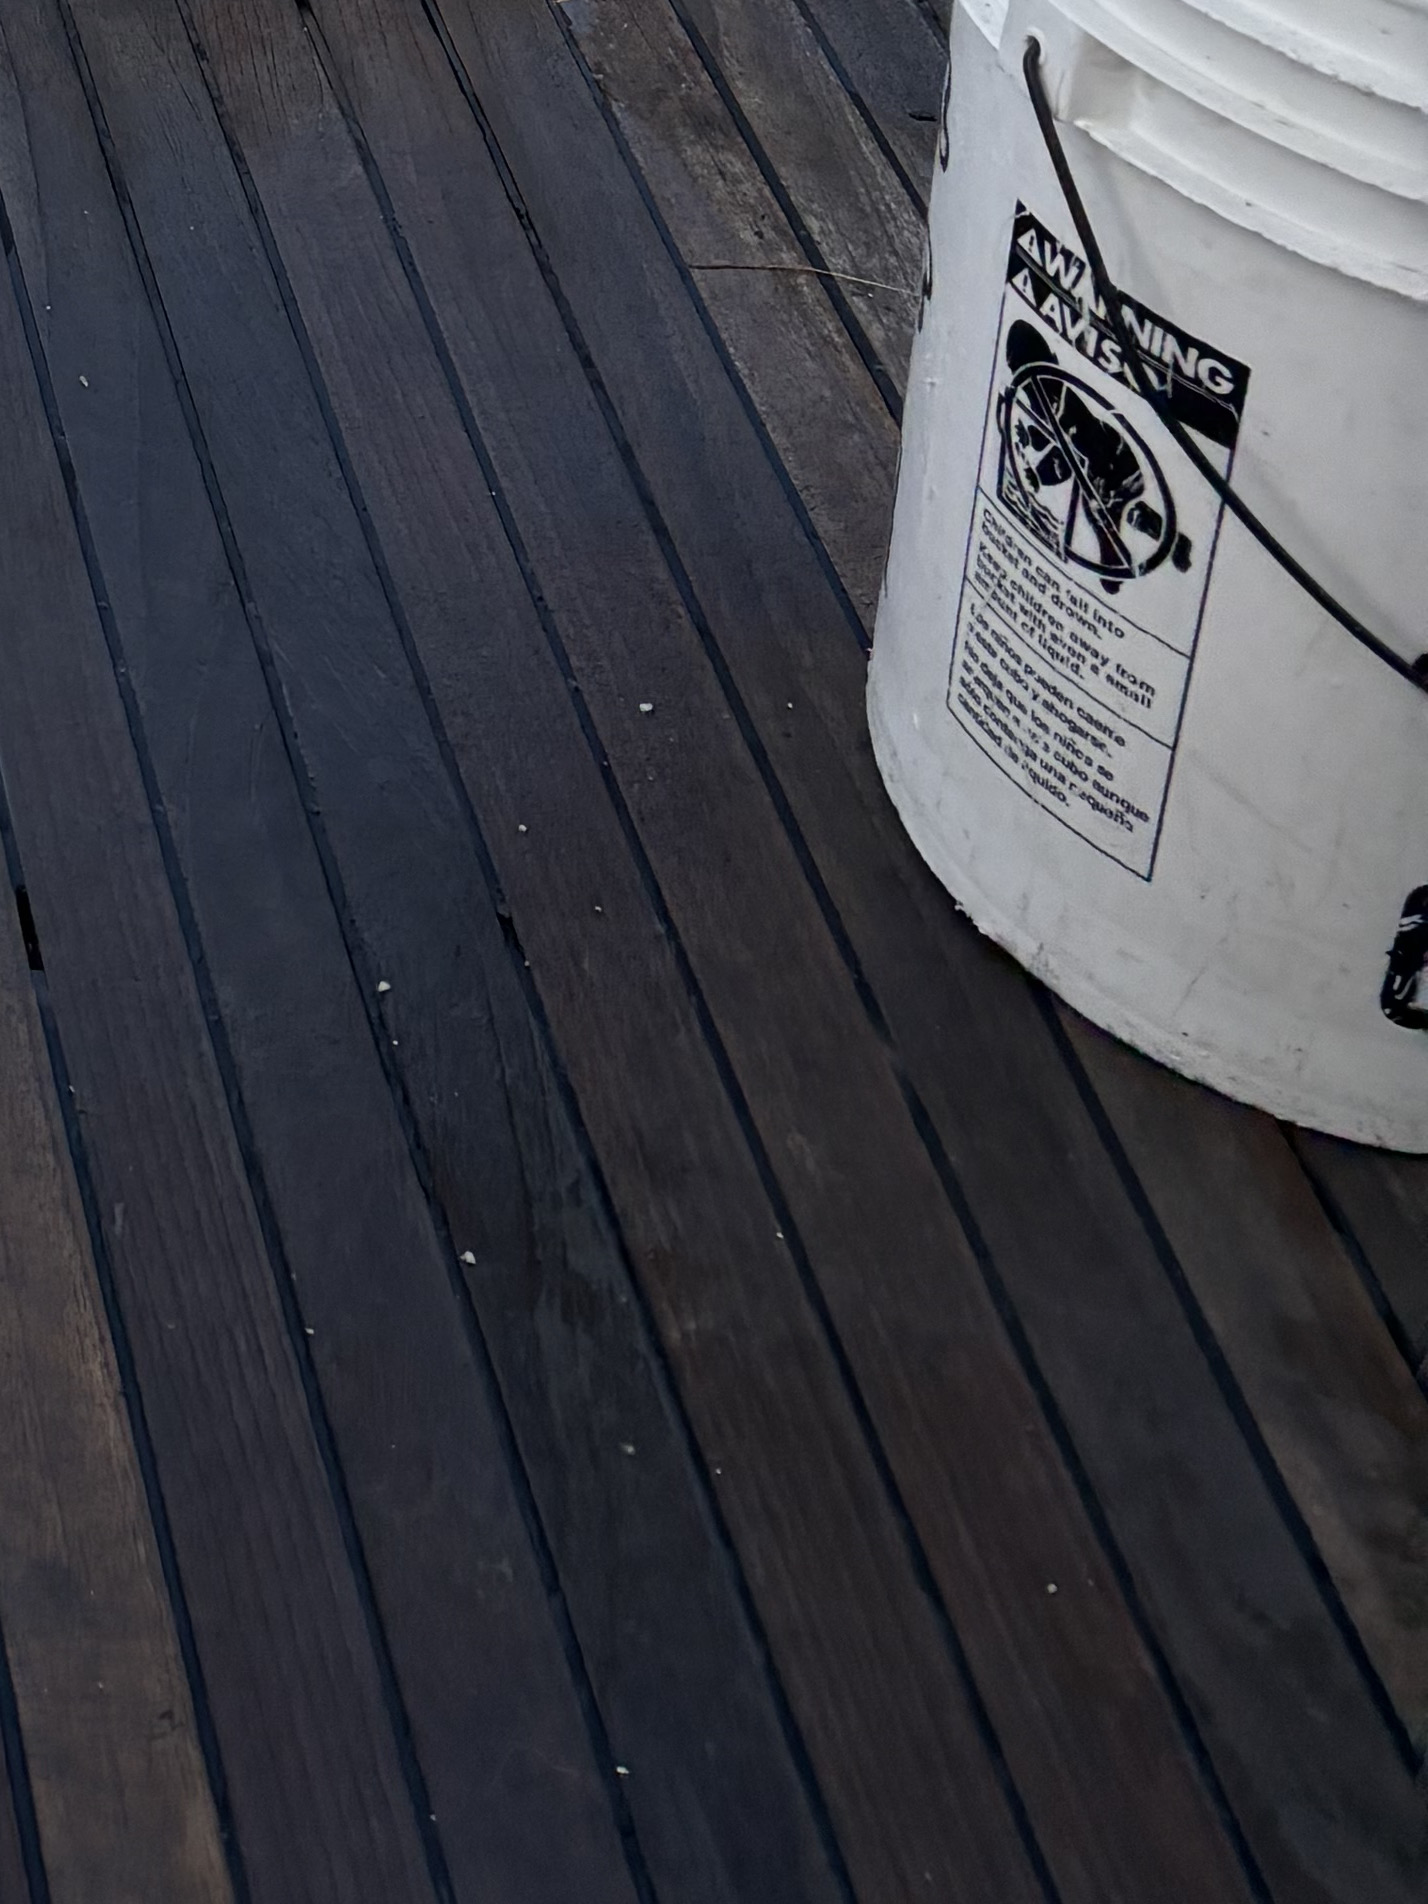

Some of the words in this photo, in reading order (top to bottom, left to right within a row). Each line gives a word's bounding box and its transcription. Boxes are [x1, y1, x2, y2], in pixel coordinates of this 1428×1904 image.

[1044, 239, 1235, 395] WANING
[982, 520, 1019, 569] bucket
[1021, 567, 1047, 595] and
[983, 508, 1032, 566] Children
[1035, 566, 1061, 593] can
[1093, 608, 1125, 639] into
[1010, 579, 1064, 632] children
[1069, 631, 1110, 667] away
[1115, 663, 1156, 696] from
[1019, 602, 1046, 633] with
[1106, 673, 1151, 709] small
[1021, 621, 1035, 638] of
[1039, 758, 1066, 785] una
[1053, 750, 1089, 782] cubo
[1092, 779, 1150, 823] aunque
